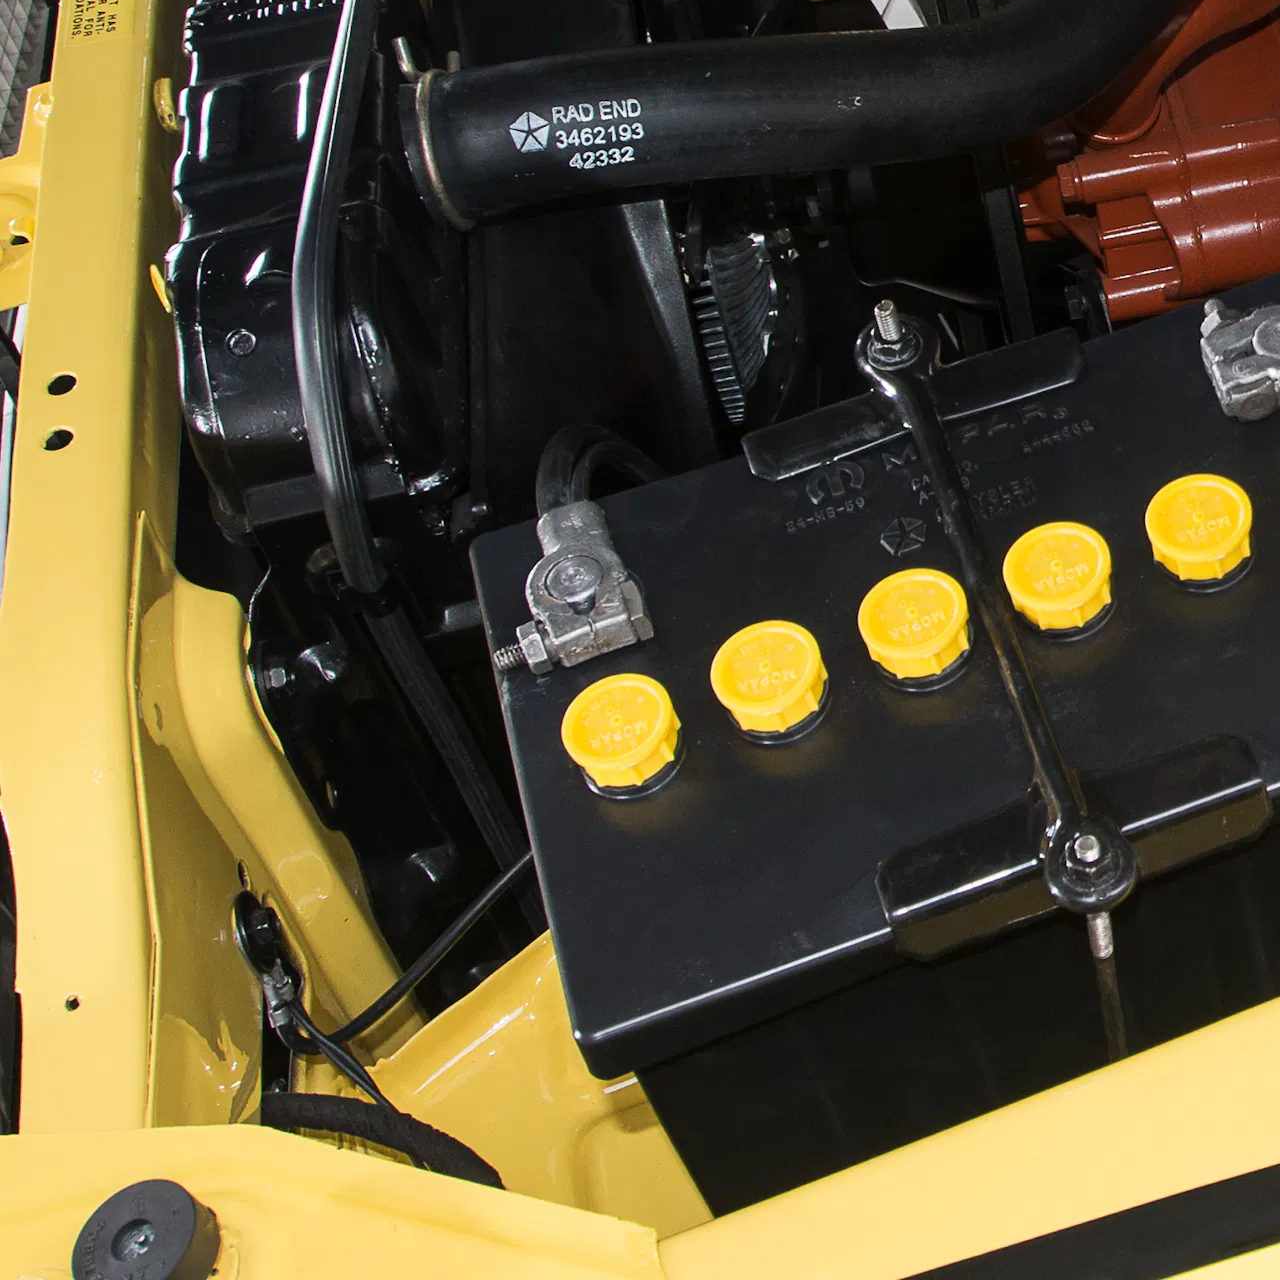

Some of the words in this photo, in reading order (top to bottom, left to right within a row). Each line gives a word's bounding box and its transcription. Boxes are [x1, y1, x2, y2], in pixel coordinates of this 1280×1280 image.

[82, 17, 94, 37] FOR
[94, 10, 105, 35] ANTI-
[105, 13, 117, 32] HAS
[552, 103, 594, 124] RAD
[599, 98, 642, 121] END
[555, 122, 644, 149] 3462193
[569, 146, 635, 169] 42332
[1173, 513, 1233, 545] MOPAR
[1031, 560, 1091, 593] MOPAR
[885, 607, 948, 642] MOPAR
[734, 664, 797, 697] MOPAR
[587, 717, 650, 750] MOPAR
